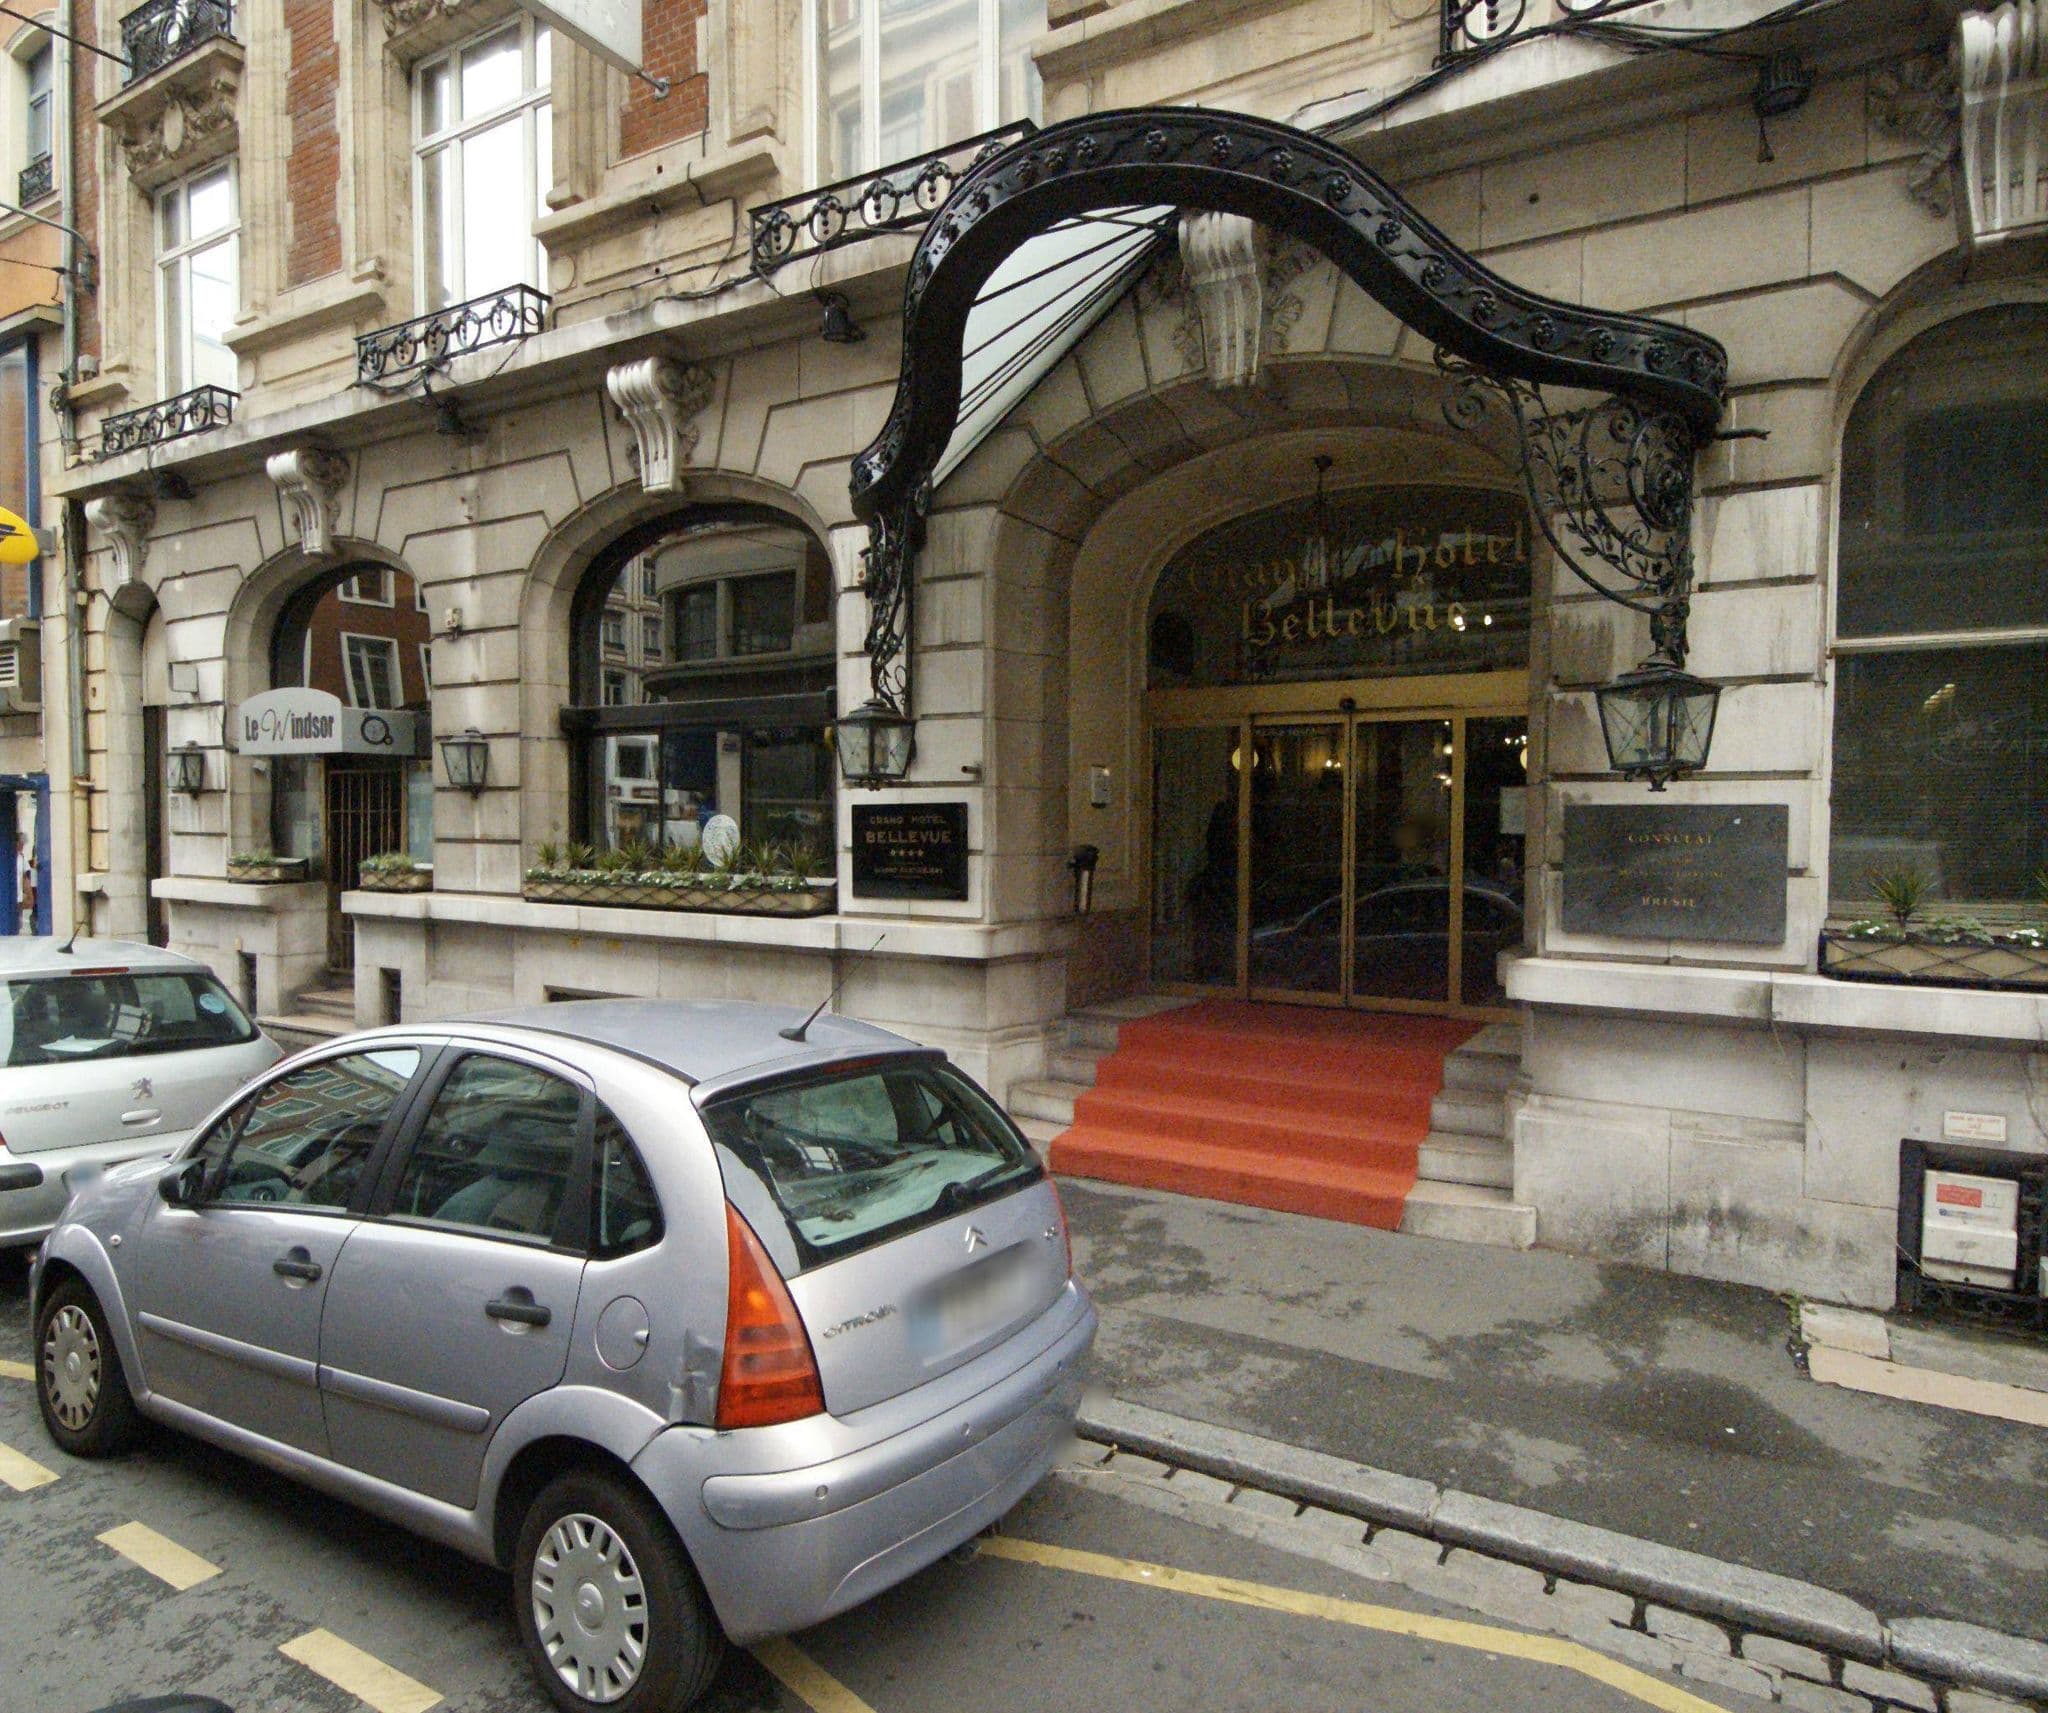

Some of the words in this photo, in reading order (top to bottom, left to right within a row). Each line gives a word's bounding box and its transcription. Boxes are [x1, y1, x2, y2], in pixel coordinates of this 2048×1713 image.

[1241, 595, 1467, 646] Bellevue
[245, 715, 259, 741] Le
[261, 708, 335, 741] Windsor
[870, 815, 905, 825] GRAND
[911, 815, 947, 825] HOTEL
[865, 830, 952, 844] BELLEVUE
[6, 1101, 70, 1114] PEUGEOT
